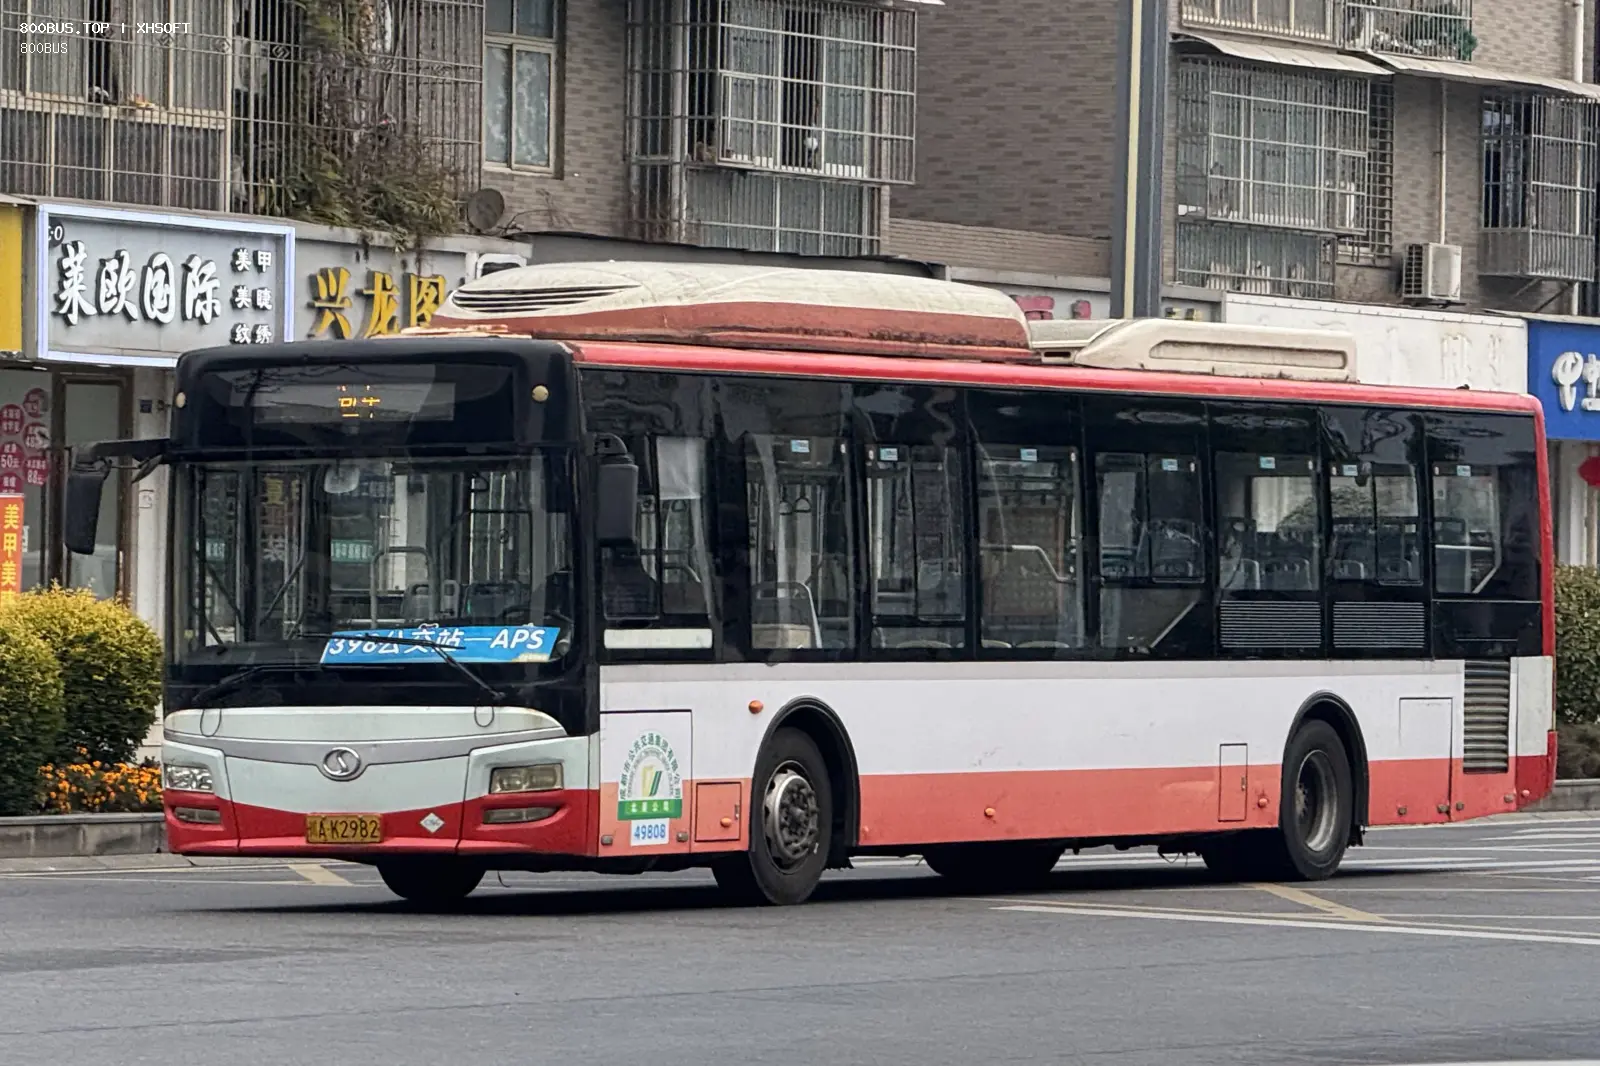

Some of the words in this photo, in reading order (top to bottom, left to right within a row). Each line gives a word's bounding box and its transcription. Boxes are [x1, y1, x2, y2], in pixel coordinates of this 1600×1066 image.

[233, 248, 272, 273] 美甲
[53, 240, 222, 326] 莱欧国际
[633, 823, 666, 840] 49808
